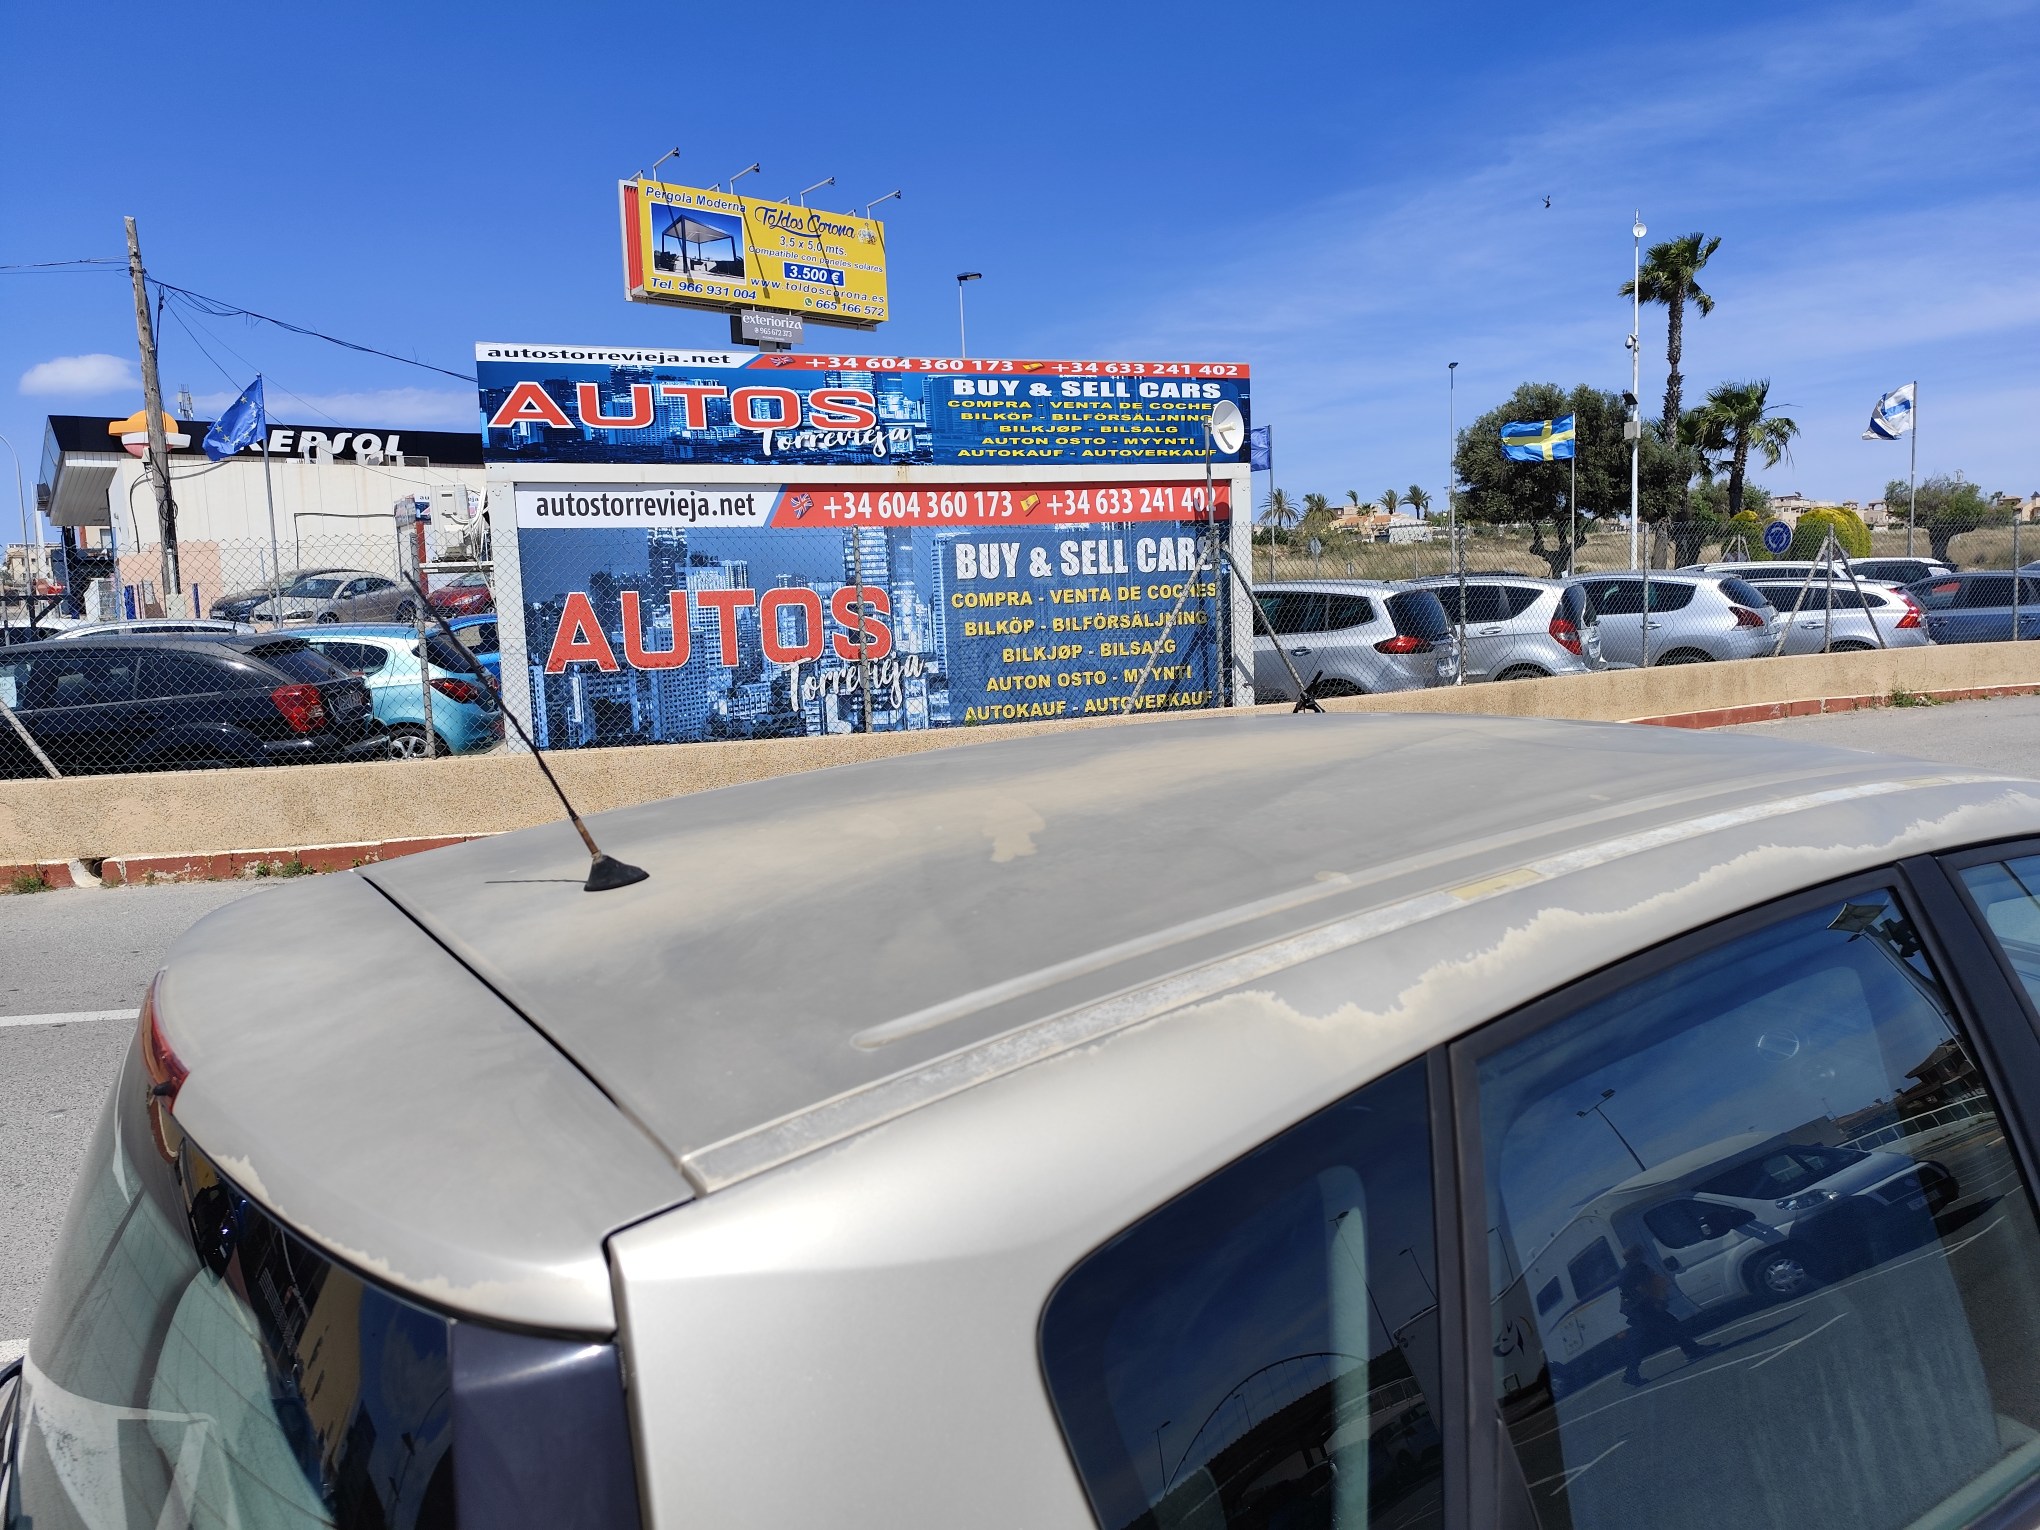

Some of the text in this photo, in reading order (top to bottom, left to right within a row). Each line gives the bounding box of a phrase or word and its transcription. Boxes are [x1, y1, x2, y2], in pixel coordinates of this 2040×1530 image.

[646, 186, 746, 212] Pérgola Moderna
[754, 206, 856, 239] Toldos Corona
[780, 236, 847, 256] 3,5 x 5,0 mts.
[748, 245, 884, 272] Compatible con paneles solares
[789, 266, 840, 284] 3.500 €
[650, 277, 758, 300] Tel. 966 931 004
[751, 278, 885, 303] www.toldoscorona.es
[816, 300, 885, 317] 665 166 572
[742, 314, 802, 330] exterioriza
[487, 346, 731, 365] autostorrevieja.net
[805, 356, 1239, 376] +34 604 360 173 +34 633 241 402
[952, 380, 1222, 399] BUY & SELL CARS
[487, 381, 877, 431] AUTOS
[947, 399, 1032, 410] COMPRA
[1050, 400, 1114, 411] VENTA
[1120, 402, 1144, 412] DE
[1149, 402, 1217, 412] COCHE
[960, 410, 1033, 422] BILKÖP
[999, 424, 1083, 434] BILKJØP
[1100, 425, 1179, 435] BILSALG
[754, 428, 912, 458] Torrevieja
[981, 436, 1050, 446] AUTON
[1054, 436, 1107, 446] OSTO
[1124, 436, 1196, 446] MYYNTI
[957, 448, 1065, 458] AUTOKAUF
[1080, 448, 1218, 458] AUTOVERKAUF
[536, 490, 756, 522] autostorrevieja.net
[823, 492, 872, 519] +34
[877, 492, 921, 518] 604
[926, 491, 968, 519] 360
[974, 490, 1012, 518] 173
[1046, 488, 1090, 516] +34
[1095, 488, 1134, 514] 633
[1140, 488, 1175, 514] 241
[956, 542, 1020, 580] BUY
[1029, 546, 1053, 578] &
[1060, 540, 1129, 576] SELL
[951, 586, 1033, 608] COMPRA
[1050, 586, 1112, 604] VENTA
[1117, 585, 1142, 602] DE
[544, 586, 892, 675] AUTOS
[965, 616, 1035, 636] BILKÖP
[1002, 643, 1084, 664] BILKJØP
[986, 672, 1052, 692] AUTON
[1056, 670, 1108, 688] OSTO
[965, 702, 1067, 722] AUTOKAUF
